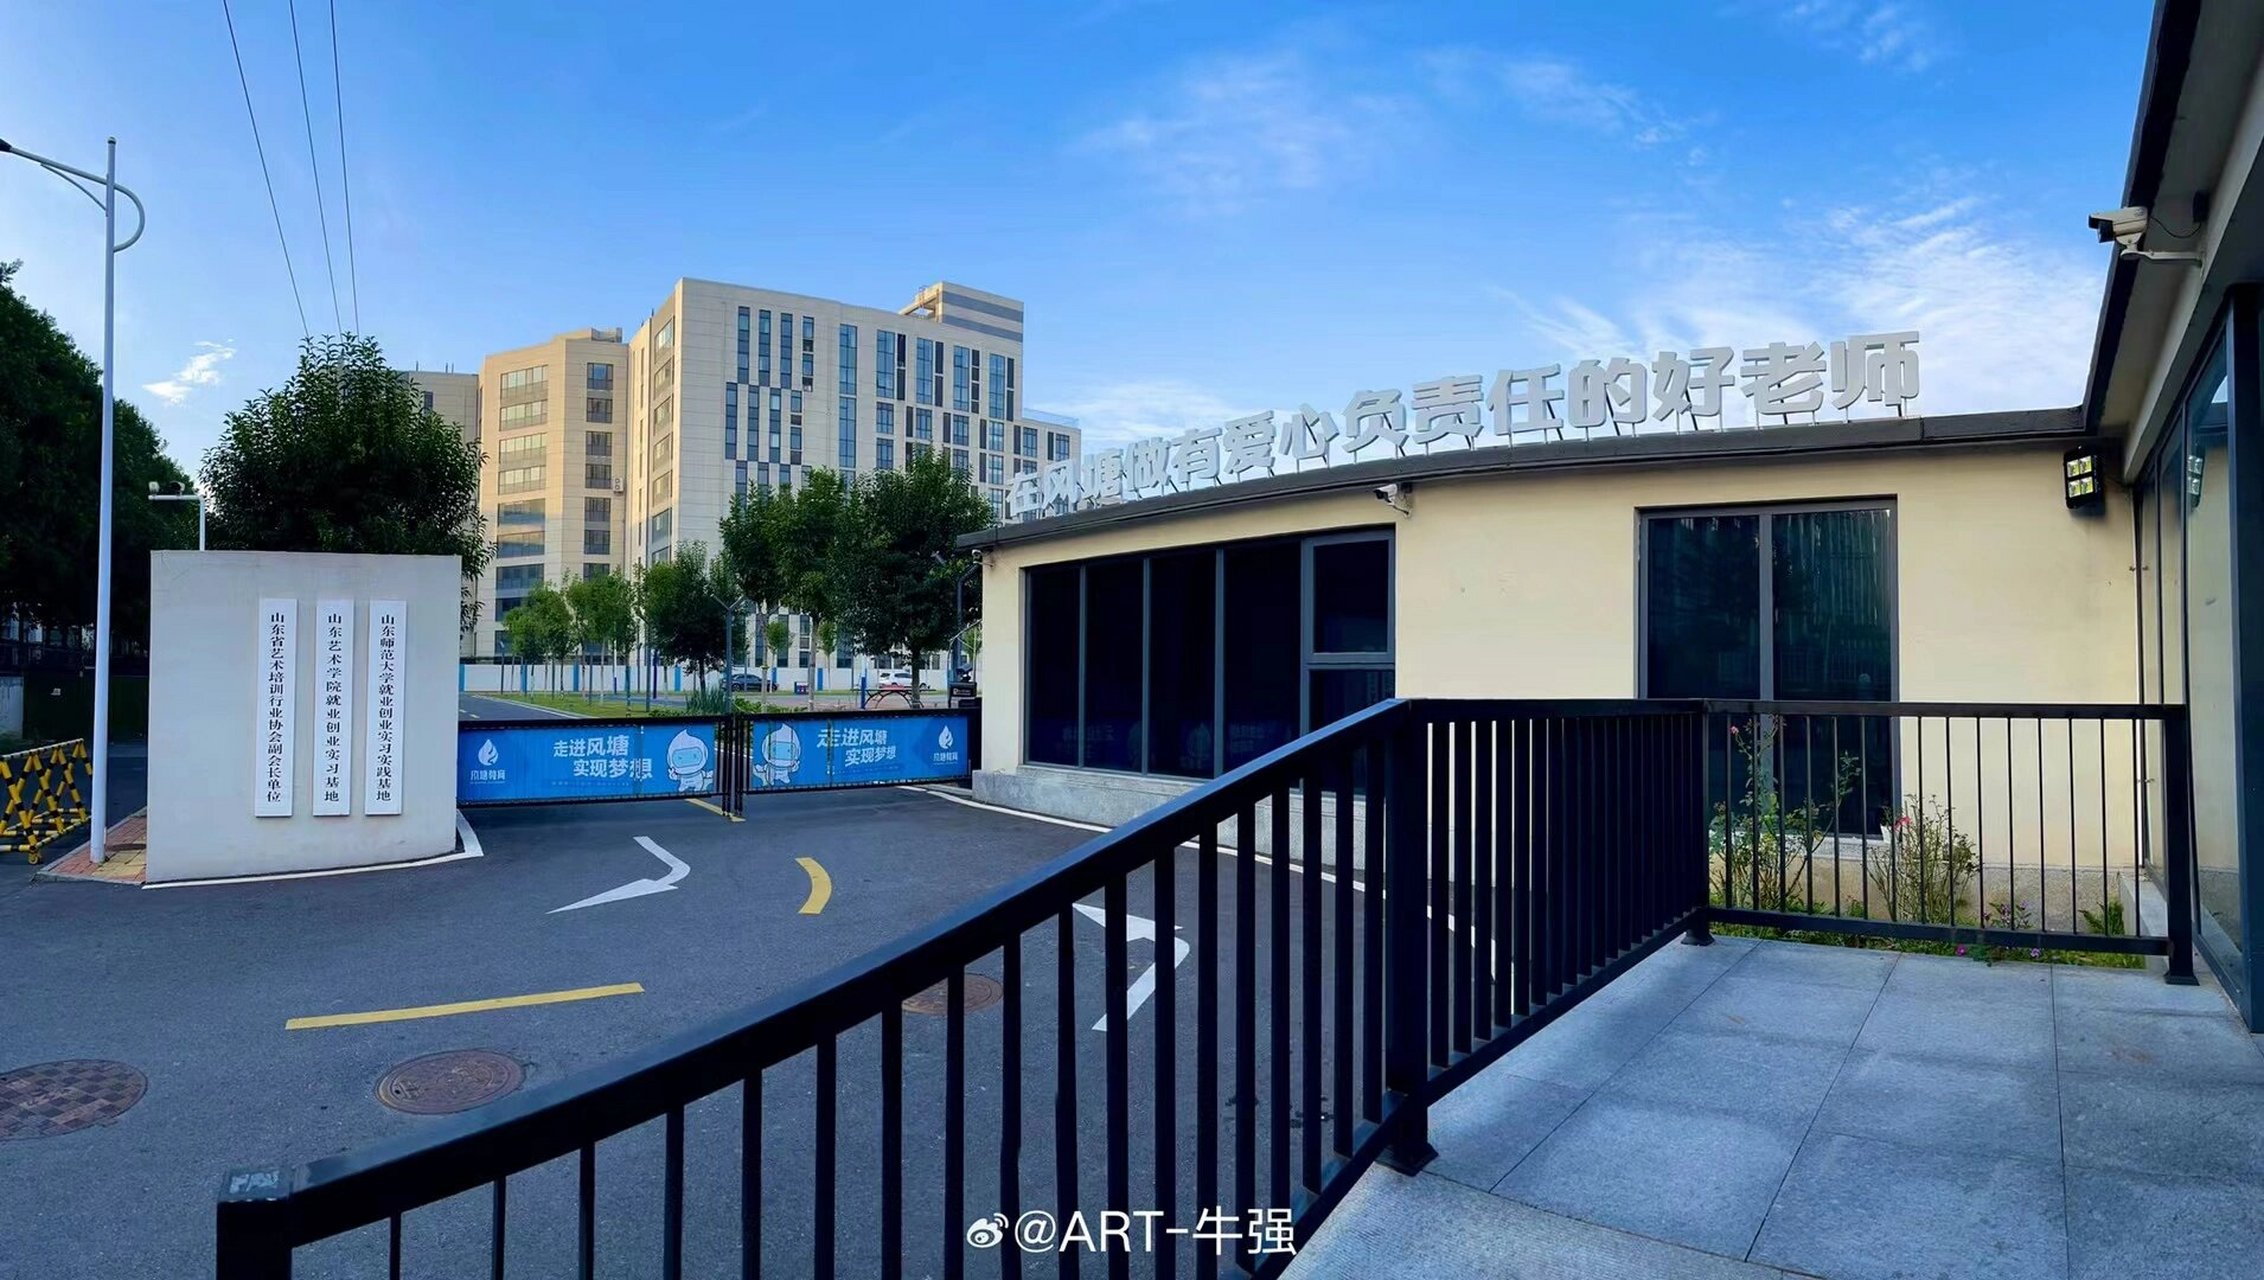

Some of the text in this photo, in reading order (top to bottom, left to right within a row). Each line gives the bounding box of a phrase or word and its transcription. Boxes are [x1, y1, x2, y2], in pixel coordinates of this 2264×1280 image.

[1007, 331, 1920, 517] 在风塘做有爱心负责任的好老师
[267, 612, 285, 803] 山东省艺术培训行业协会副会长单位
[324, 613, 342, 802] 山东艺术学院就业创业实习基地
[376, 614, 396, 801] 山东师范大学就业创业实习实践基地
[553, 734, 630, 757] 走进风塘
[816, 727, 887, 747] 走进风塘
[844, 745, 897, 767] 实现梦想
[573, 758, 653, 780] 实现梦想
